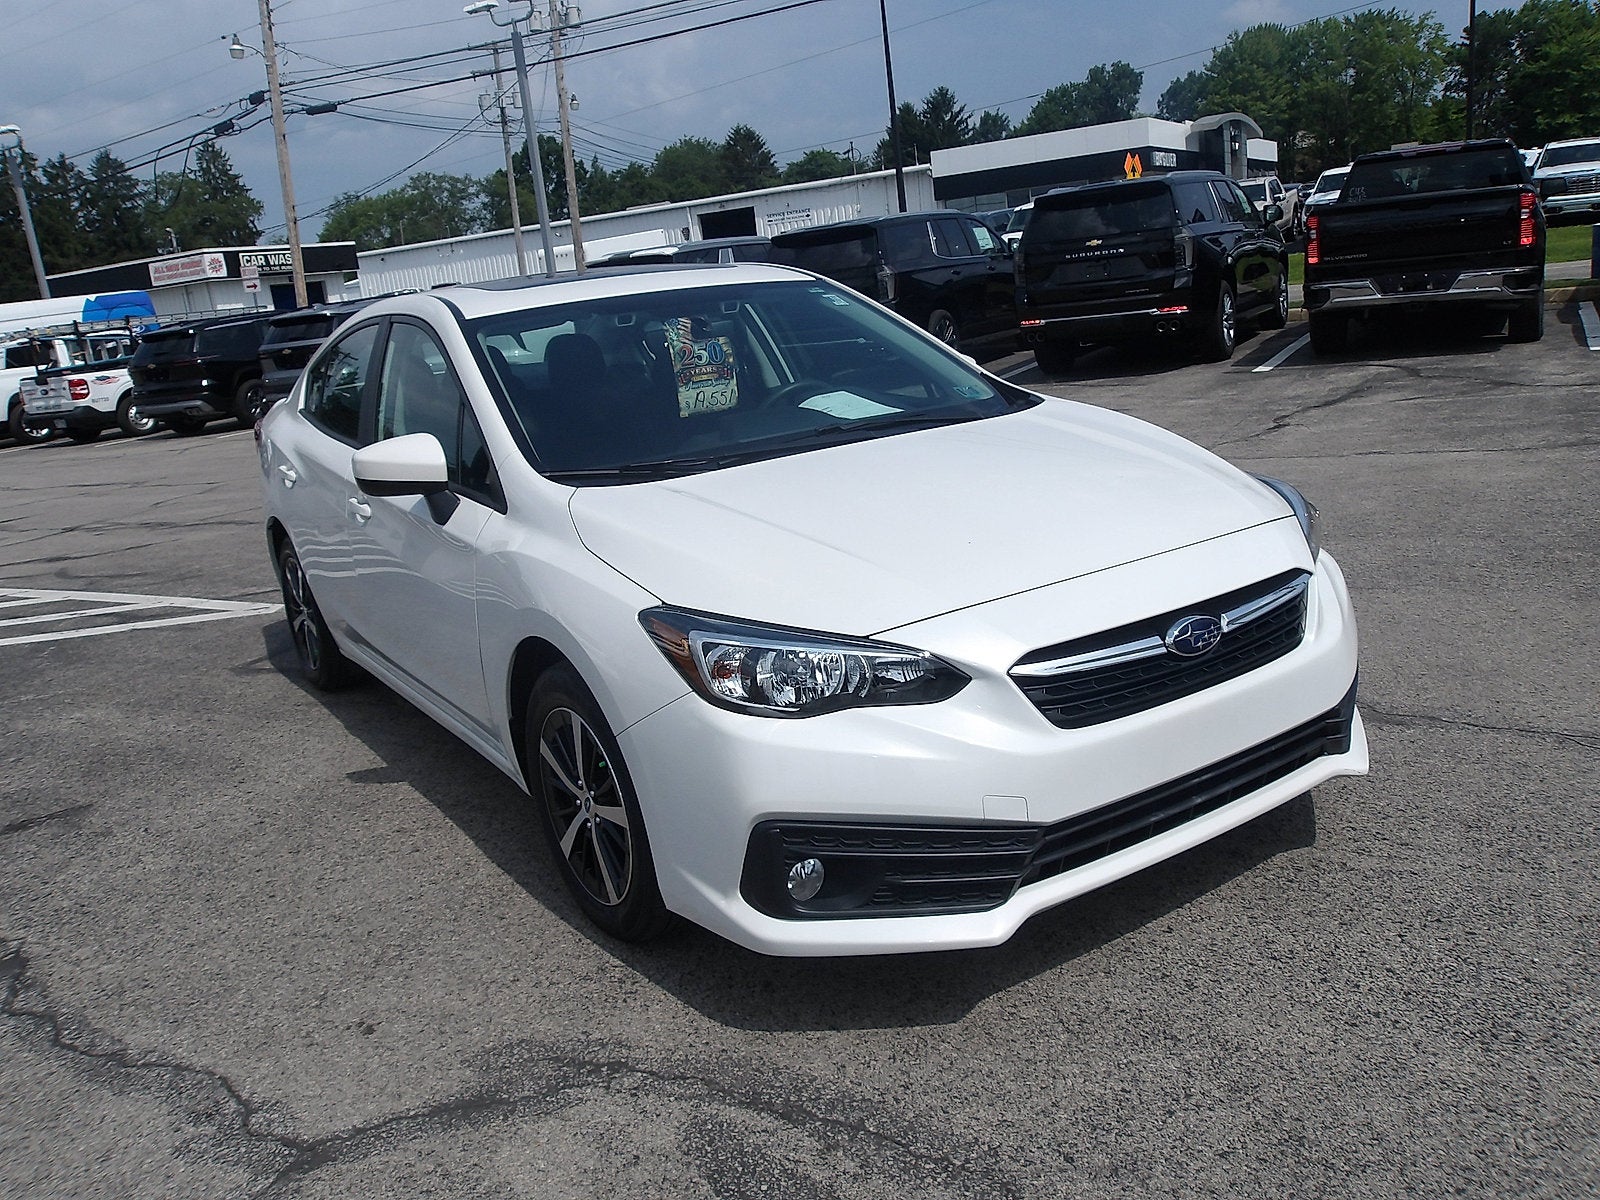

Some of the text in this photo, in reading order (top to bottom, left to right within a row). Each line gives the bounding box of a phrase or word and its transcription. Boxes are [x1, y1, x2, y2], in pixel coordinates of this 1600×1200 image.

[1065, 248, 1125, 259] SUBURBAN
[243, 253, 293, 267] CAR WAS
[679, 340, 725, 368] 250
[690, 366, 718, 374] YEARS
